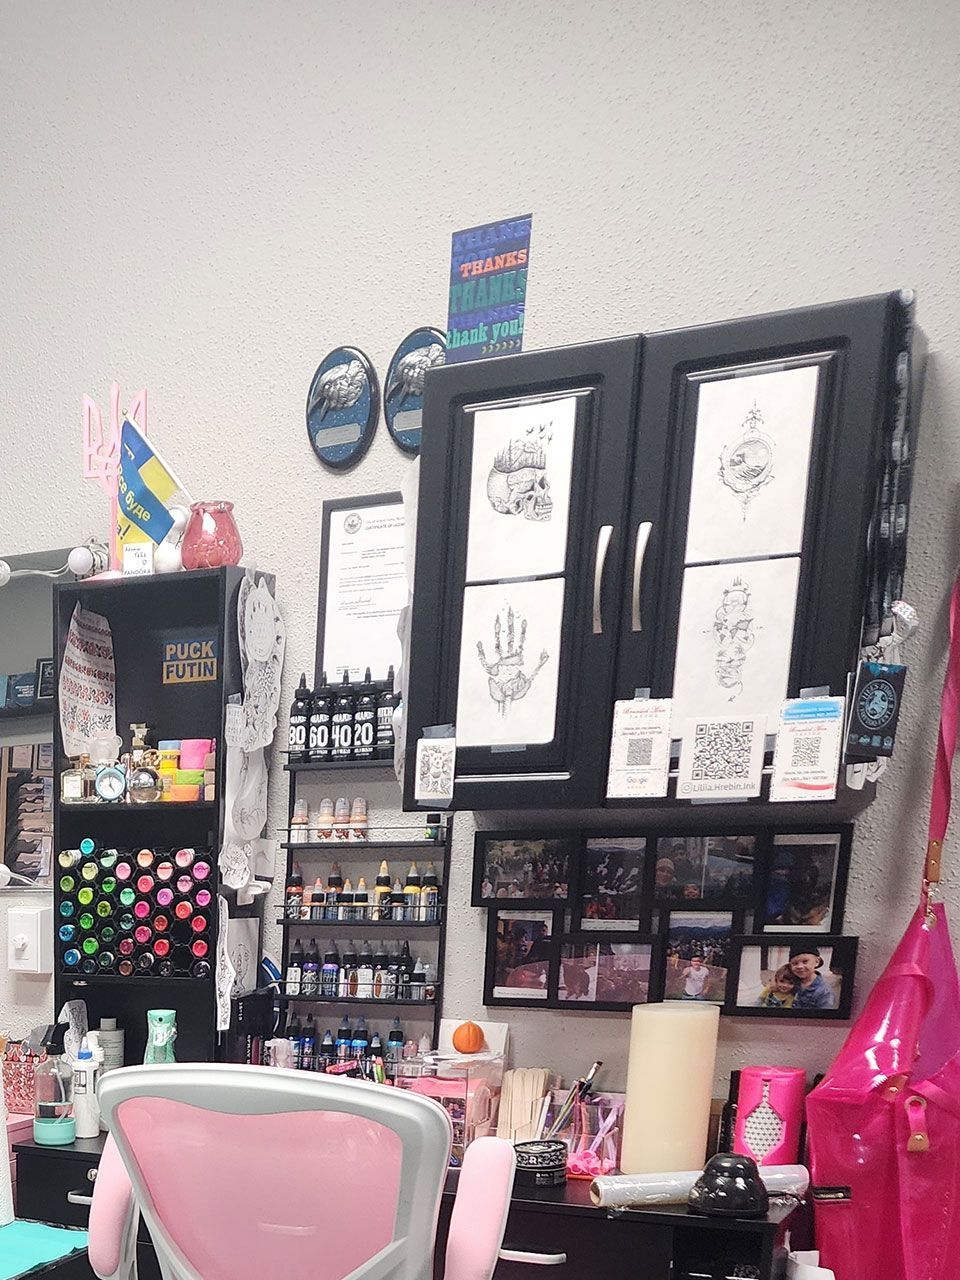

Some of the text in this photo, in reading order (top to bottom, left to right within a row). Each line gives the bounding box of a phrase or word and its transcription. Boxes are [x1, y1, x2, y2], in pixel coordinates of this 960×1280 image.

[460, 248, 527, 277] THANKS
[450, 268, 528, 315] THANKS
[446, 312, 523, 349] thank you!
[125, 490, 151, 522] буде
[166, 640, 215, 660] PUCK
[166, 660, 214, 680] FUTIN
[289, 725, 306, 745] 80
[309, 725, 328, 748] 60
[331, 724, 352, 748] 40
[354, 722, 373, 746] 20
